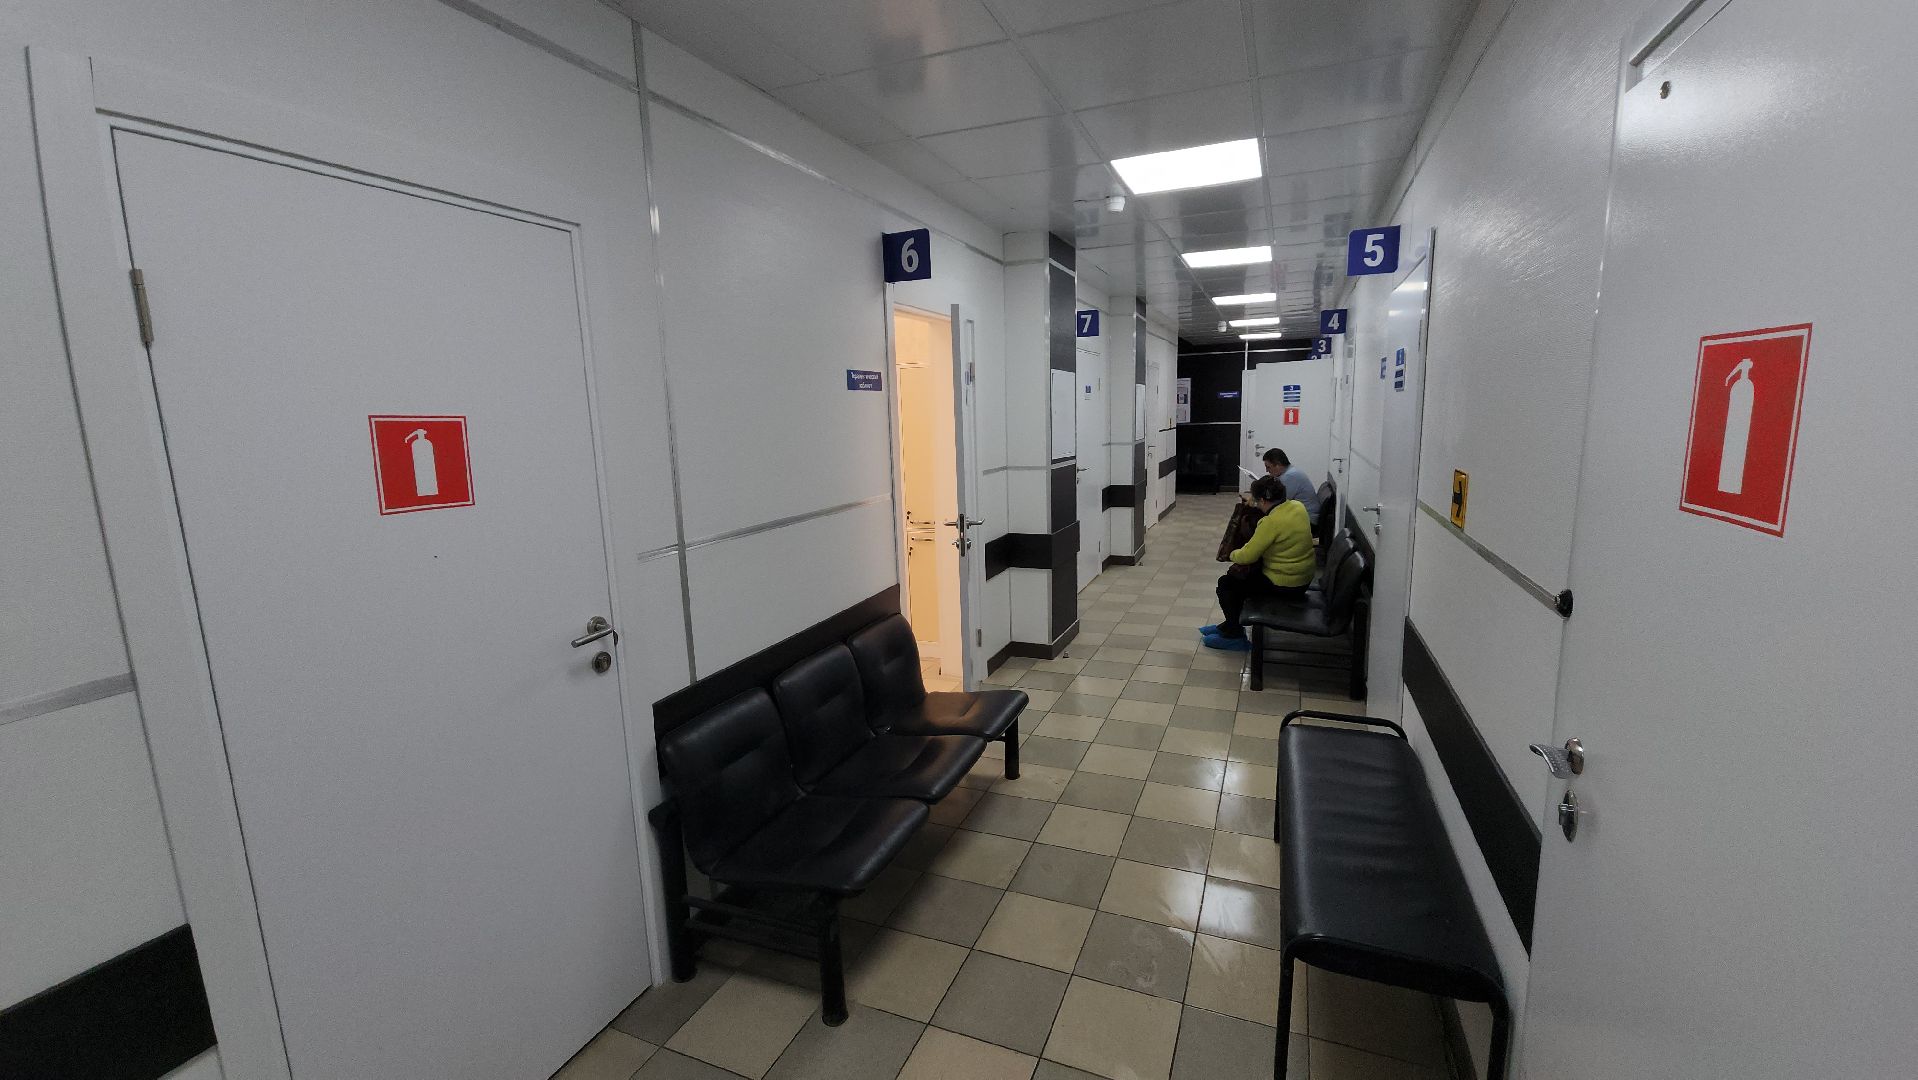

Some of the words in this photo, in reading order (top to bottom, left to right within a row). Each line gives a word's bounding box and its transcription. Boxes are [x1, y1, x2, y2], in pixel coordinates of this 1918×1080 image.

[901, 237, 919, 272] 6
[1363, 233, 1385, 267] 5
[1080, 314, 1092, 333] 7
[1328, 313, 1340, 330] 4
[1318, 339, 1327, 352] 3
